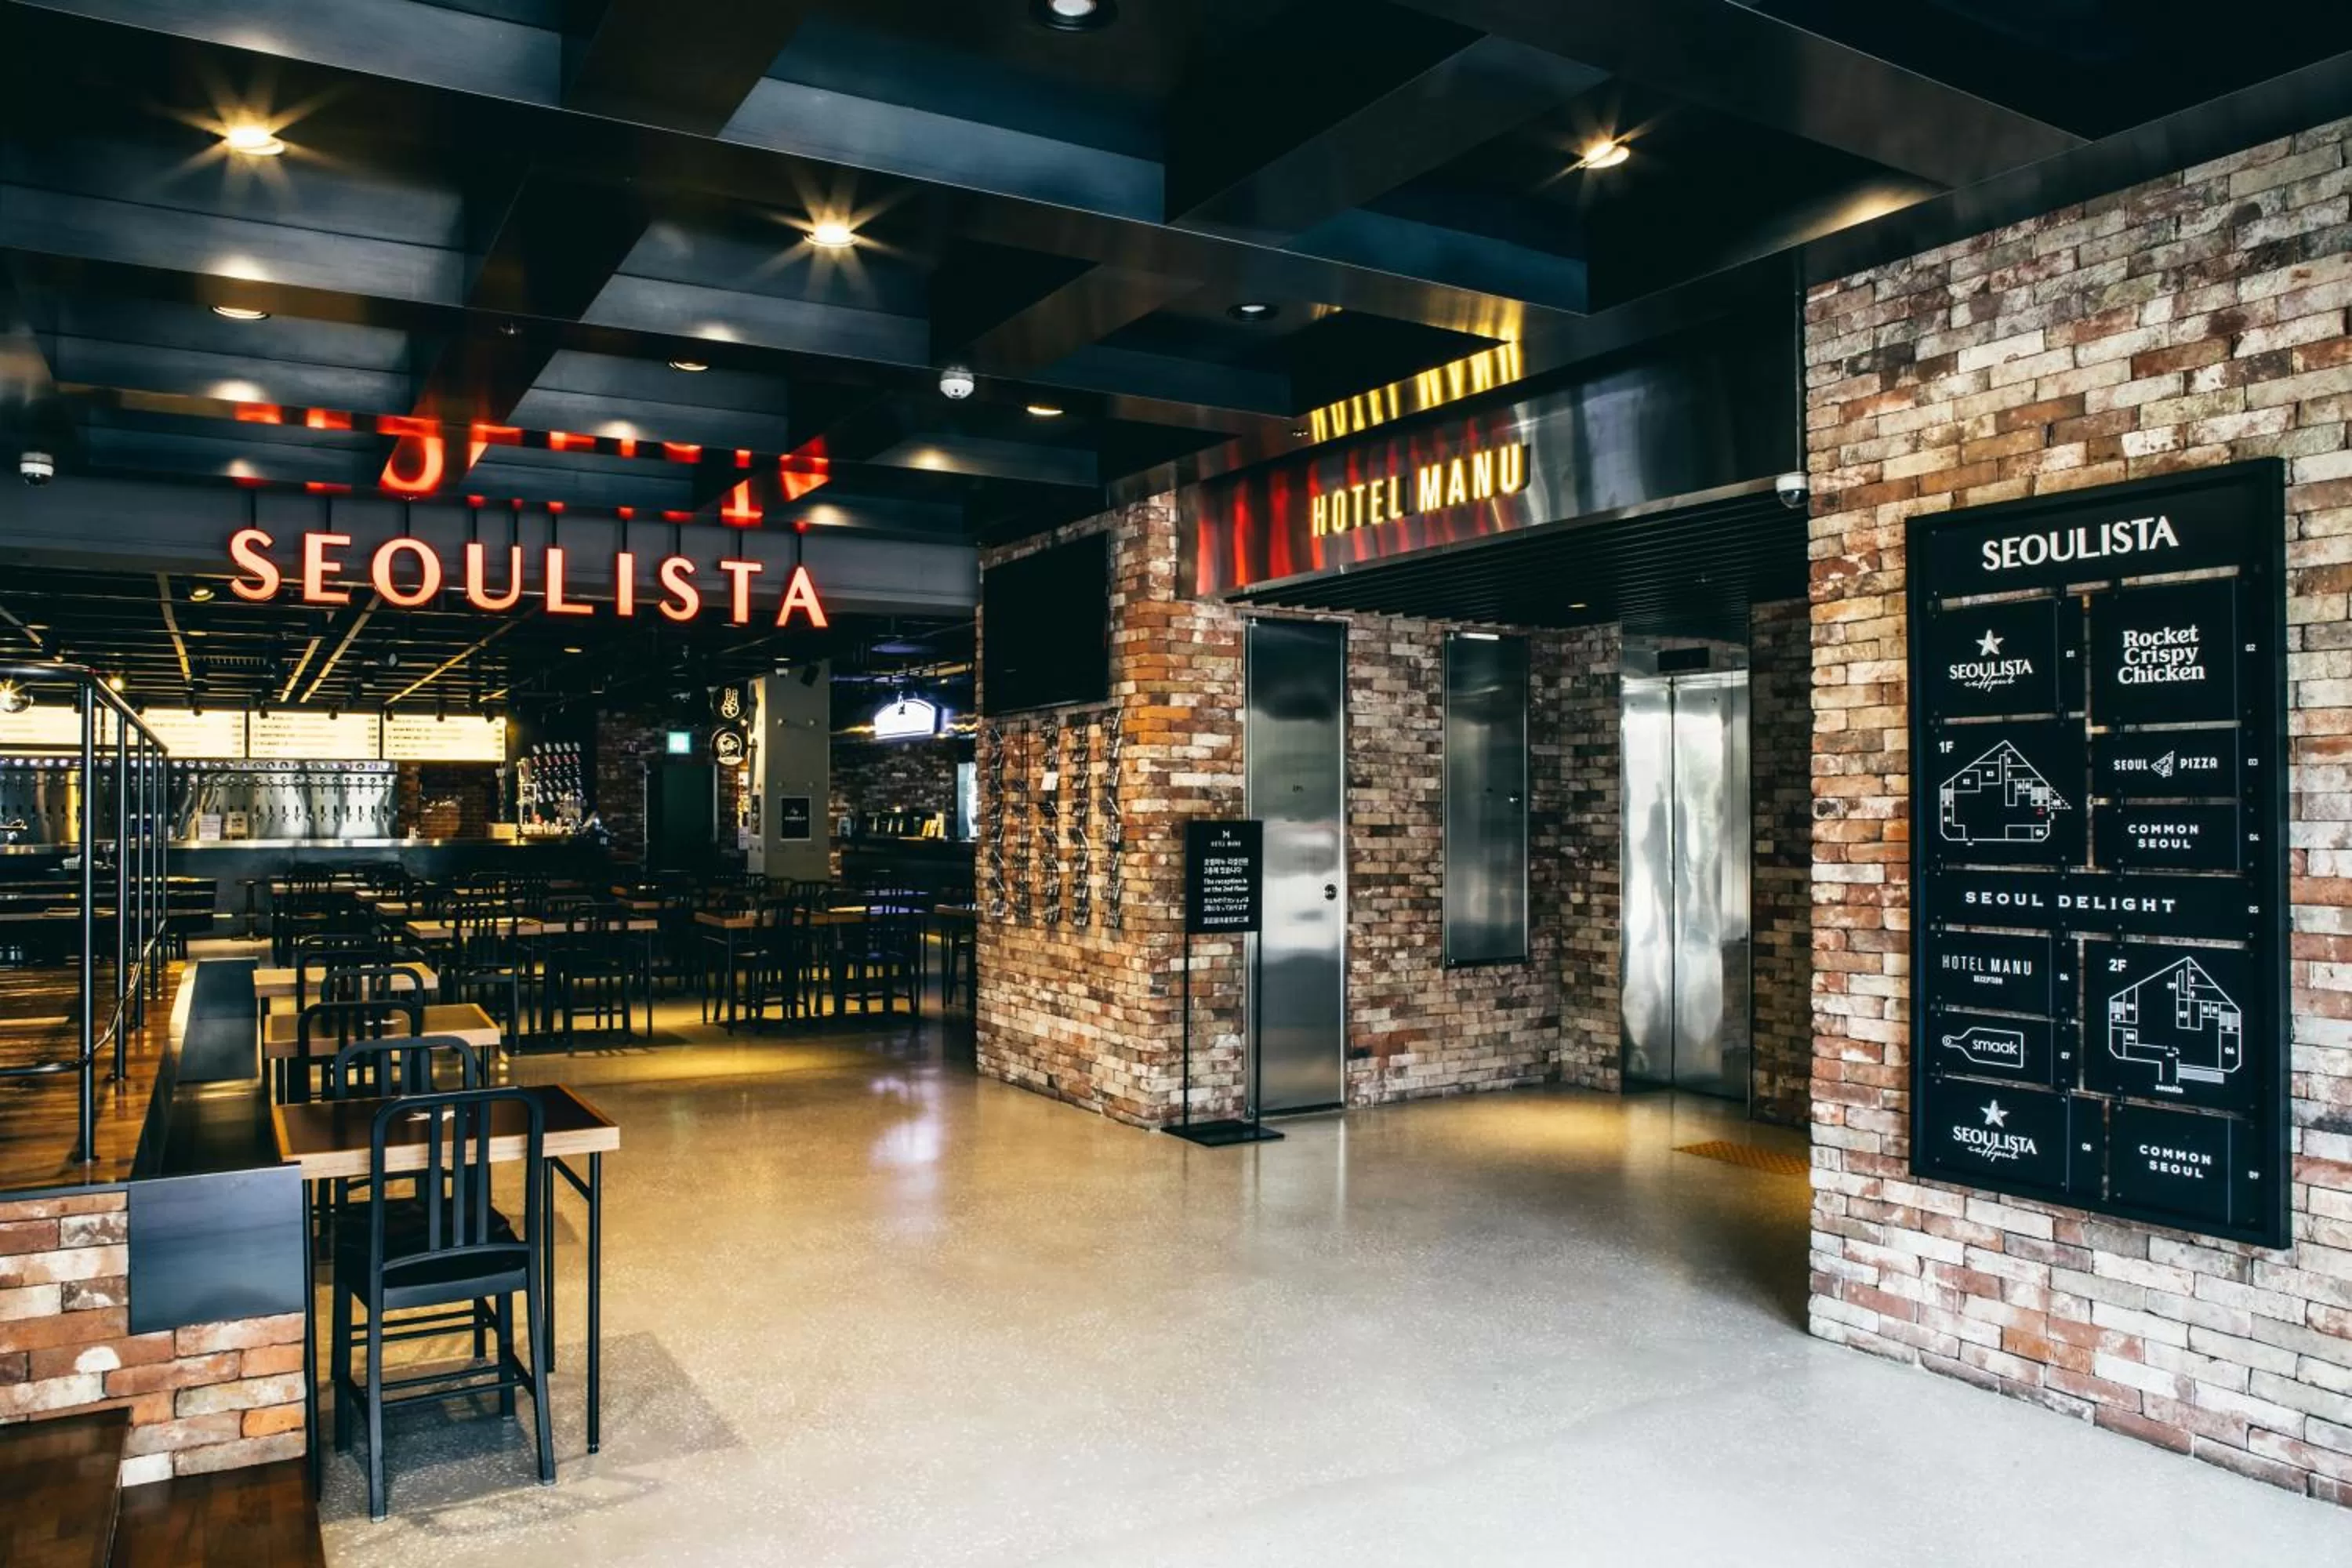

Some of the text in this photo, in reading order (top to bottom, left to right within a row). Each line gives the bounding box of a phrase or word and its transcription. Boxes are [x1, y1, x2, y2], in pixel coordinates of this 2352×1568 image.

[1311, 443, 1523, 539] HOTEL MANU
[1982, 515, 2180, 572] SEOULISTA
[228, 527, 829, 629] SEOULISTA
[2122, 623, 2201, 648] Rocket
[2123, 645, 2200, 666] Crispy
[1948, 658, 2034, 680] SEOULISTA
[2117, 663, 2206, 685] Chicken
[1940, 742, 1953, 753] 1F
[2114, 757, 2217, 770] SEOUL PIZZA
[2129, 825, 2198, 834] COMMON
[2139, 839, 2190, 848] SEOUL
[1966, 892, 2175, 912] SEOUL DELIGHT
[1943, 956, 2031, 975] HOTEL MANU
[2109, 959, 2126, 971] 2F
[1973, 1040, 2017, 1054] smaak
[1952, 1125, 2038, 1156] SEOULISTA
[2139, 1144, 2212, 1166] COMMON
[2148, 1160, 2204, 1179] SEOUL
